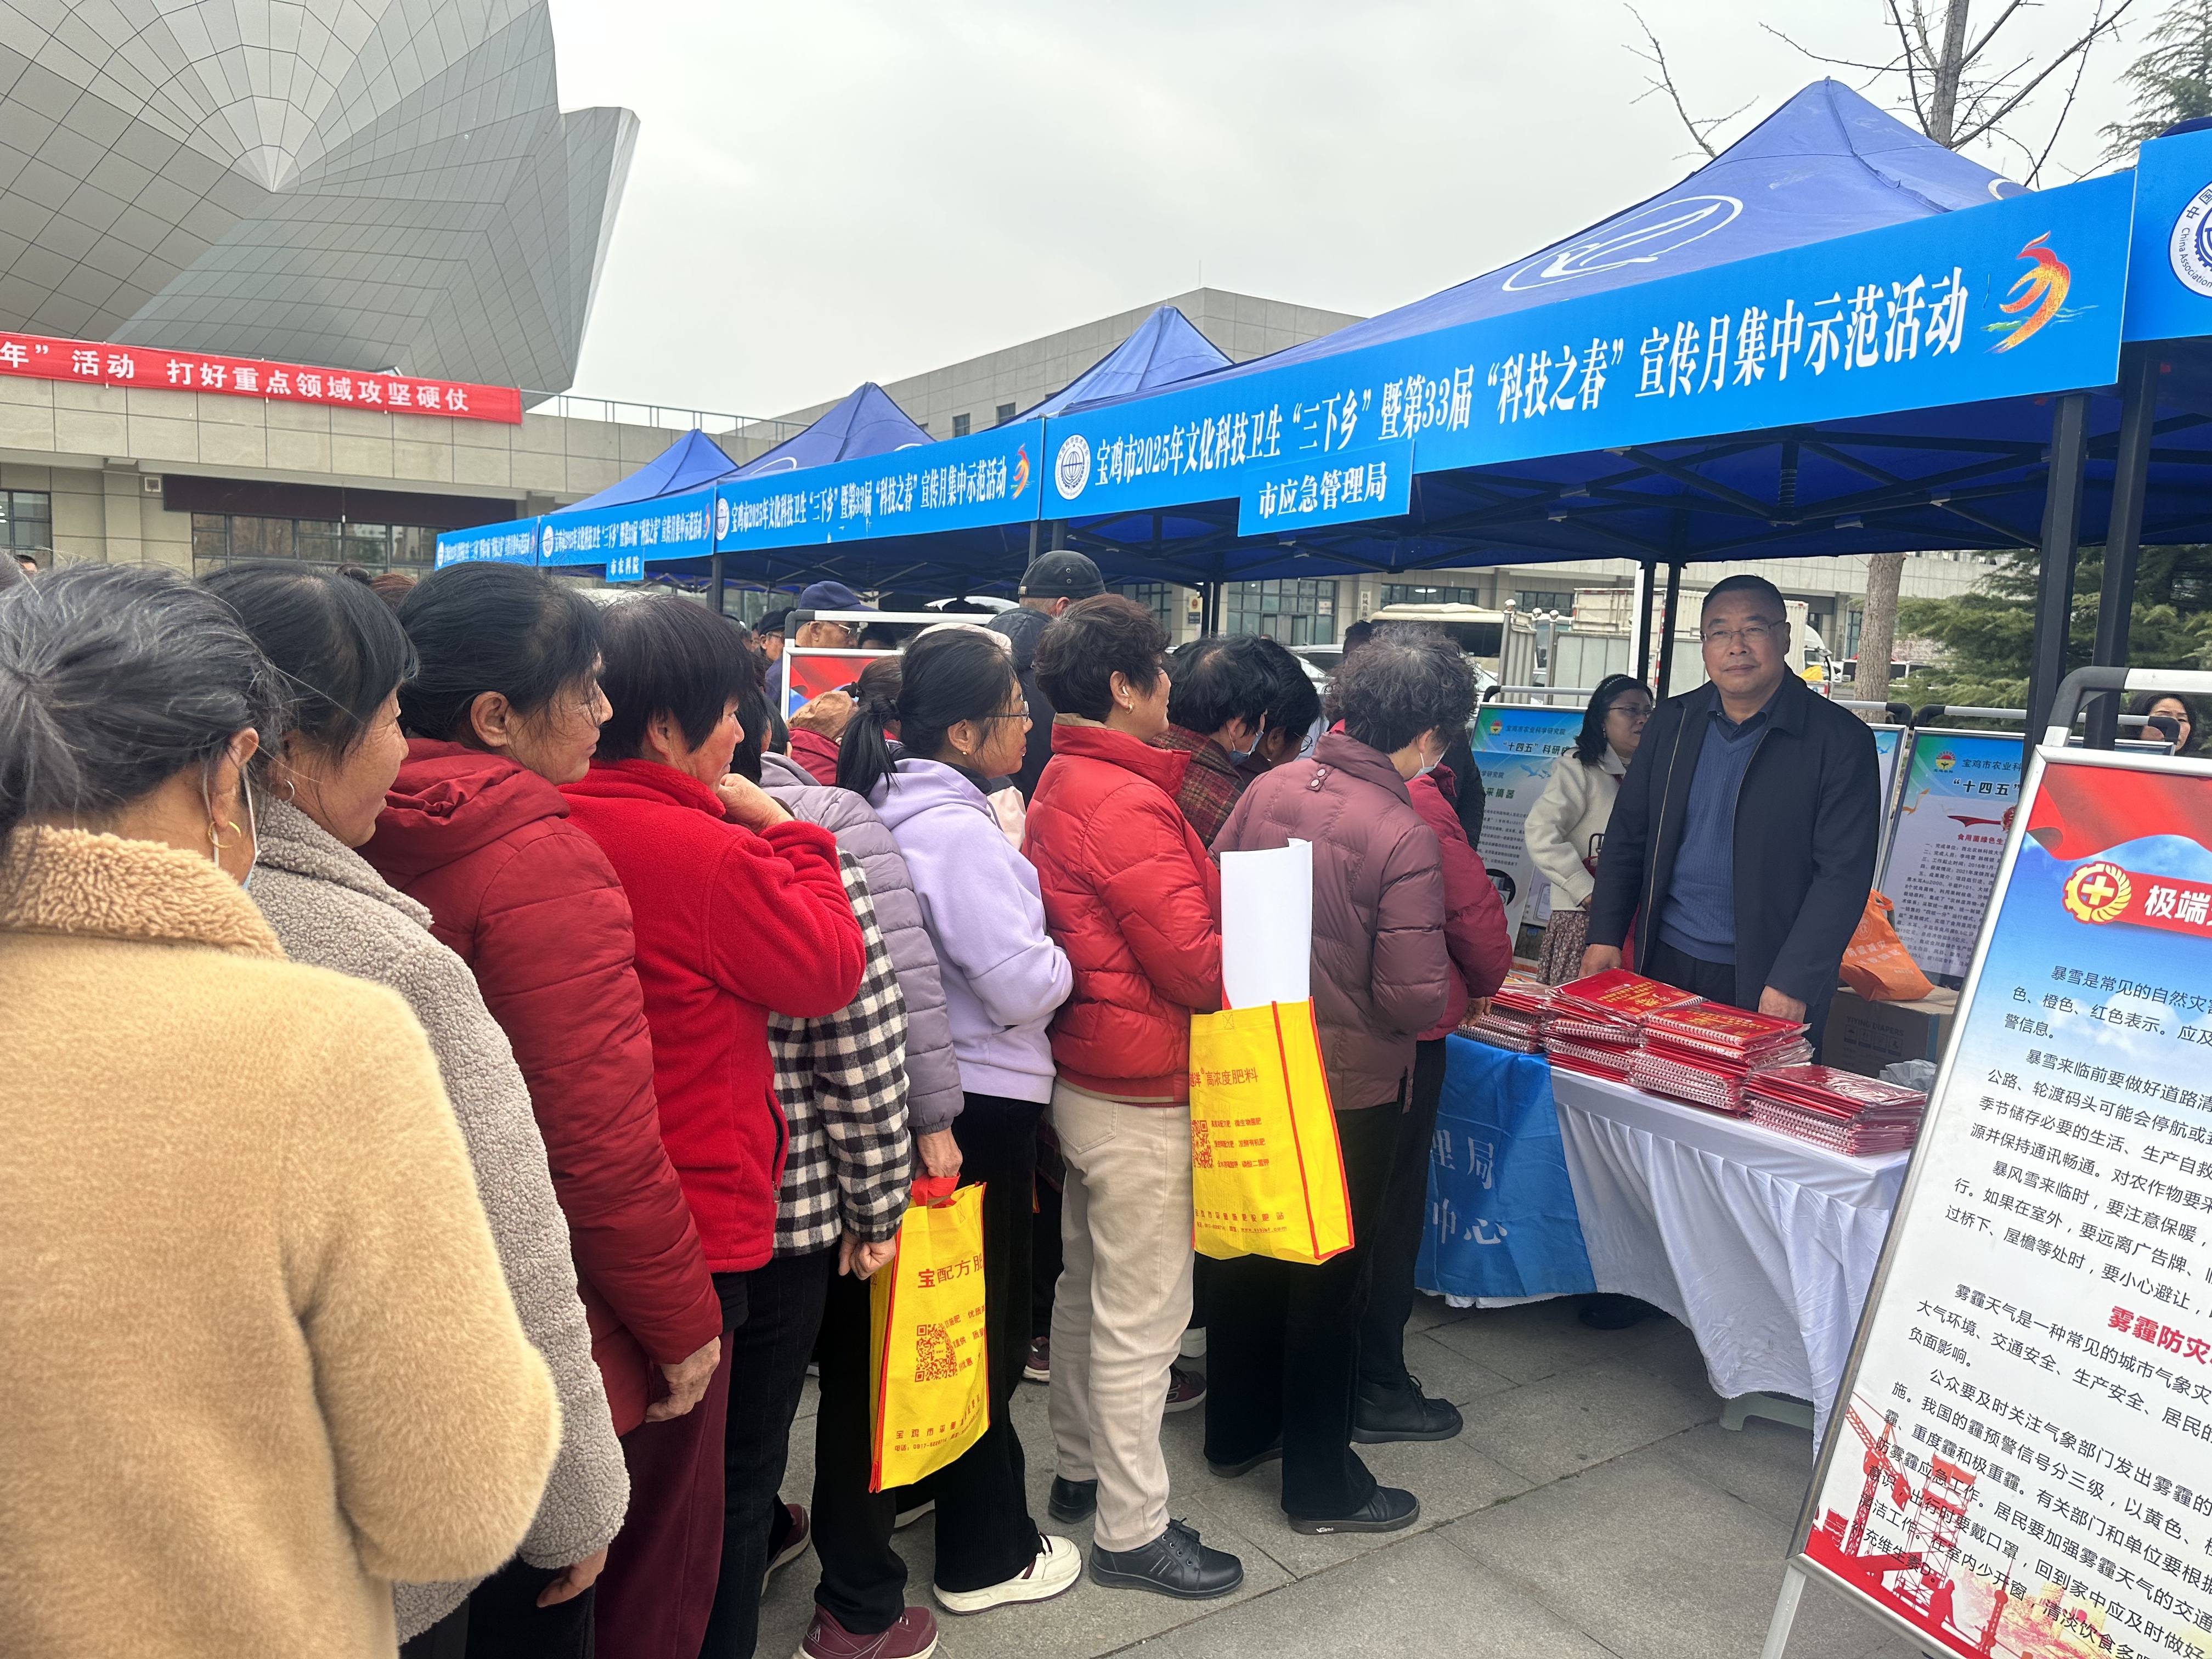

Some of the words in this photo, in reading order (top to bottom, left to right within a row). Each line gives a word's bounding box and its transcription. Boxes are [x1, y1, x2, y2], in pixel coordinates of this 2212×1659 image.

[2179, 228, 2190, 252] China
[2180, 253, 2212, 288] Association
[167, 358, 469, 411] 打好重点领域攻坚硬仗
[1258, 461, 1387, 520] 市应急管理局
[1484, 787, 1515, 799] 采摘器
[1953, 778, 2020, 795] “十四五”
[1957, 833, 2006, 845] 食用菌绿色生
[2144, 885, 2212, 926] 极端
[2051, 966, 2212, 1015] 暴雪是常见的自然灾
[1847, 1016, 1871, 1028] YIYING
[1872, 1022, 1904, 1036] DIAPERS
[2004, 1013, 2055, 1039] 警信息。
[1205, 1067, 1258, 1087] 高浓度肥料
[2026, 1049, 2212, 1113] 暴雪来临前要做好道路清
[1432, 1198, 1508, 1244] 中心
[1908, 1327, 1971, 1367] 负面影响。
[1955, 1284, 2212, 1405] 雾霾天气是一种常见的城市气象灾
[1930, 1369, 2212, 1516] 公众要及时关注气象部门发出雾霾的
[1860, 1492, 2151, 1659] 清洁工作。在室内少开窗，清淡饮食多
